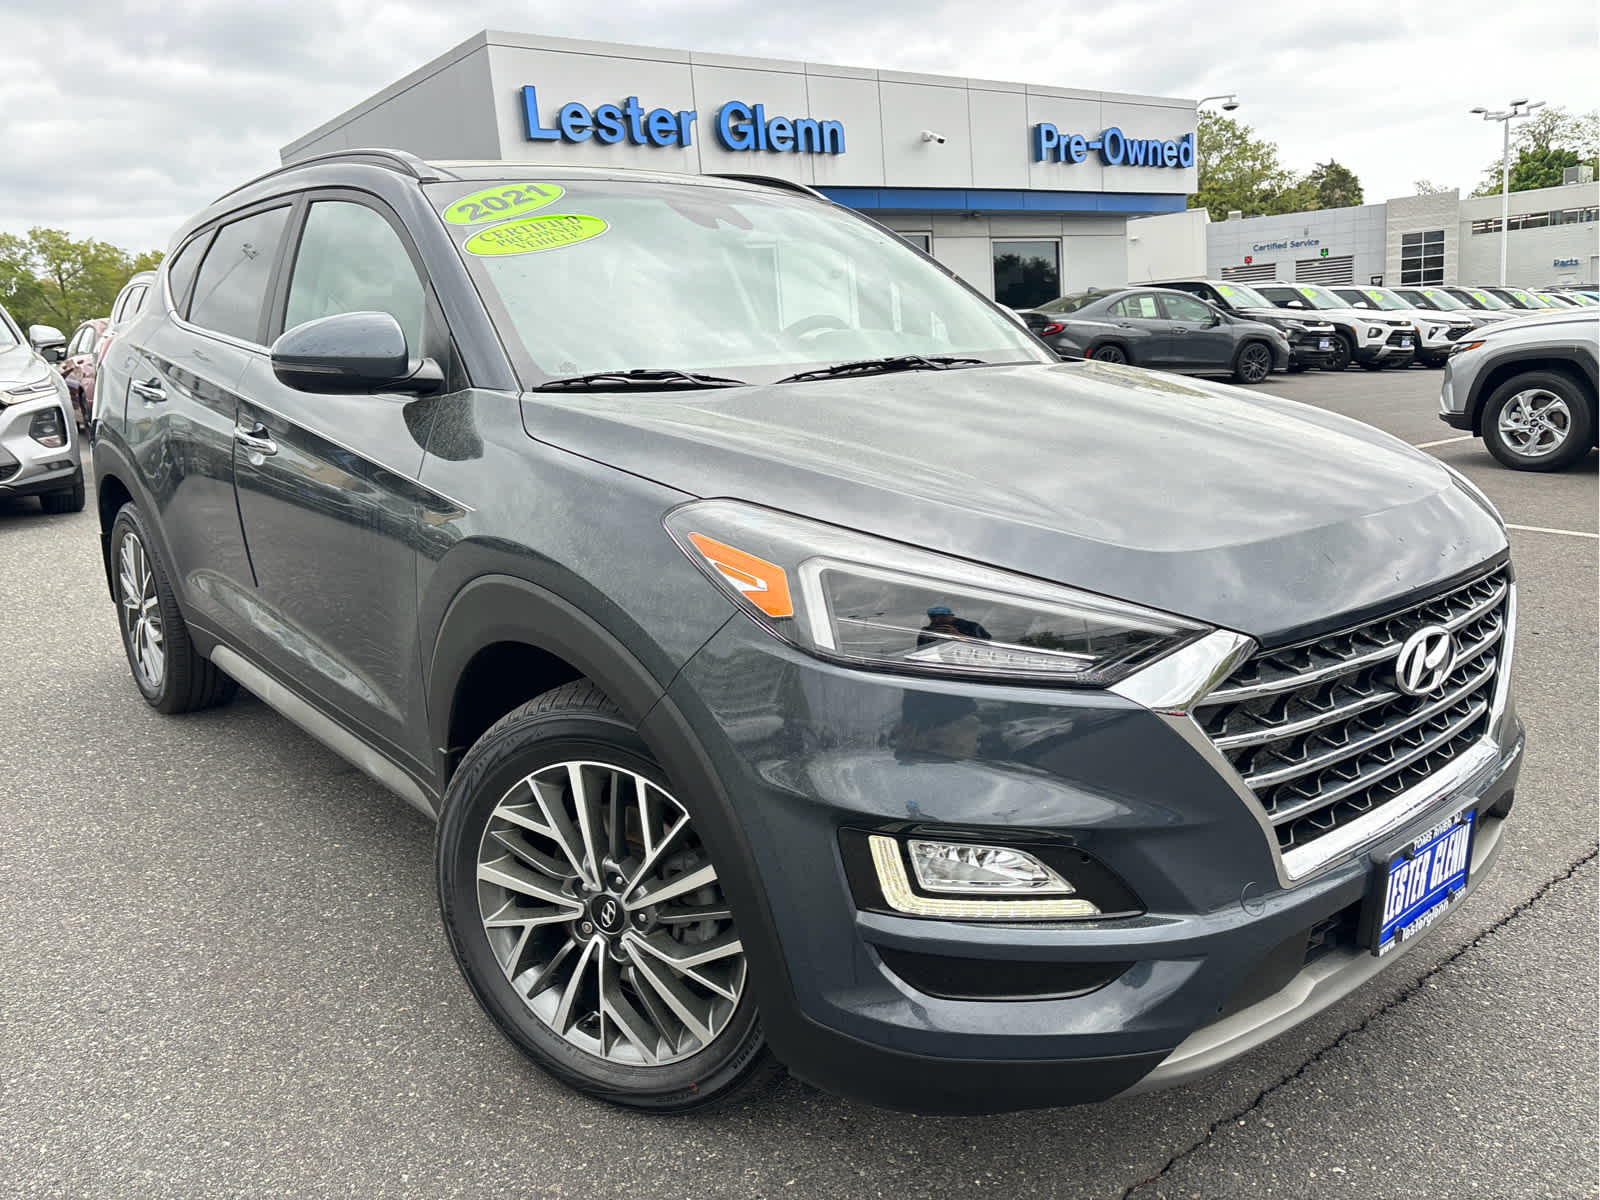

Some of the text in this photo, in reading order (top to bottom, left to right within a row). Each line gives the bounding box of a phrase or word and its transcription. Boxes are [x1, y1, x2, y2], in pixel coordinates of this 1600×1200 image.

[519, 85, 846, 154] Lester Glenn
[1034, 122, 1194, 169] Pre-Owned
[457, 184, 552, 222] 2021
[479, 215, 581, 242] CERTIFIED
[1252, 239, 1320, 252] Certified Service
[1553, 258, 1579, 267] Parts
[1382, 820, 1471, 926] LESTER GLENN
